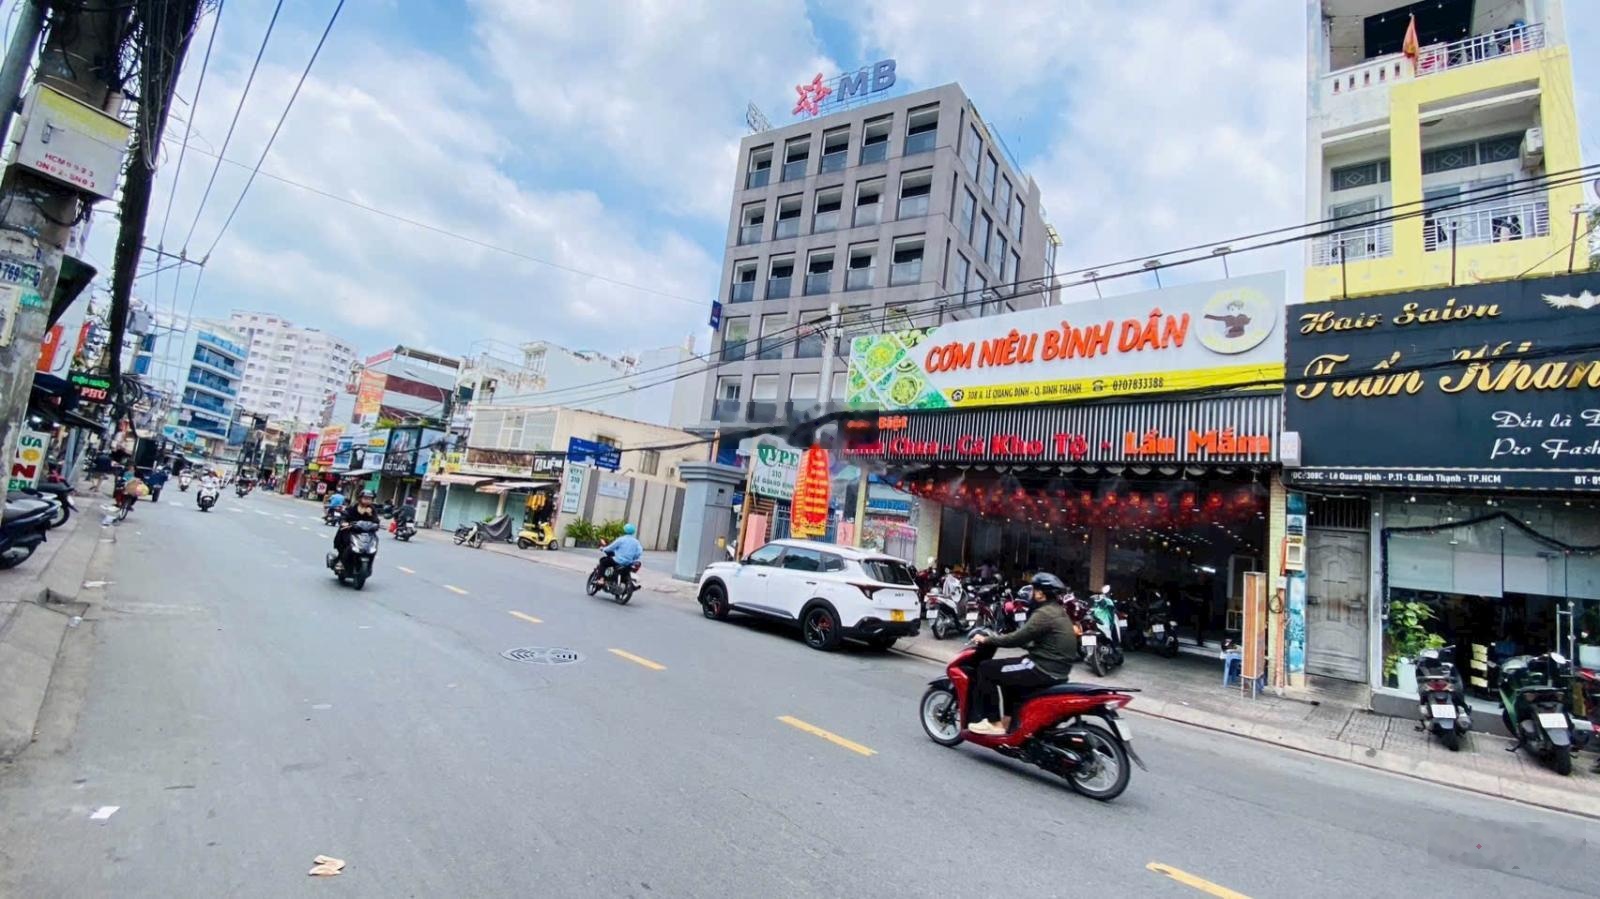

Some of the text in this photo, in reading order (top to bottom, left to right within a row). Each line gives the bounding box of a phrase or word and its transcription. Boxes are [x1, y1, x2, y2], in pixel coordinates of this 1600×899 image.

[836, 59, 897, 102] MB
[1299, 310, 1382, 335] Hair
[925, 307, 1191, 374] CƠM NIÊU BÌNH DÂN
[1491, 410, 1543, 429] Đến
[1550, 412, 1572, 428] là
[991, 432, 1045, 457] Kho
[1490, 437, 1532, 460] Pro
